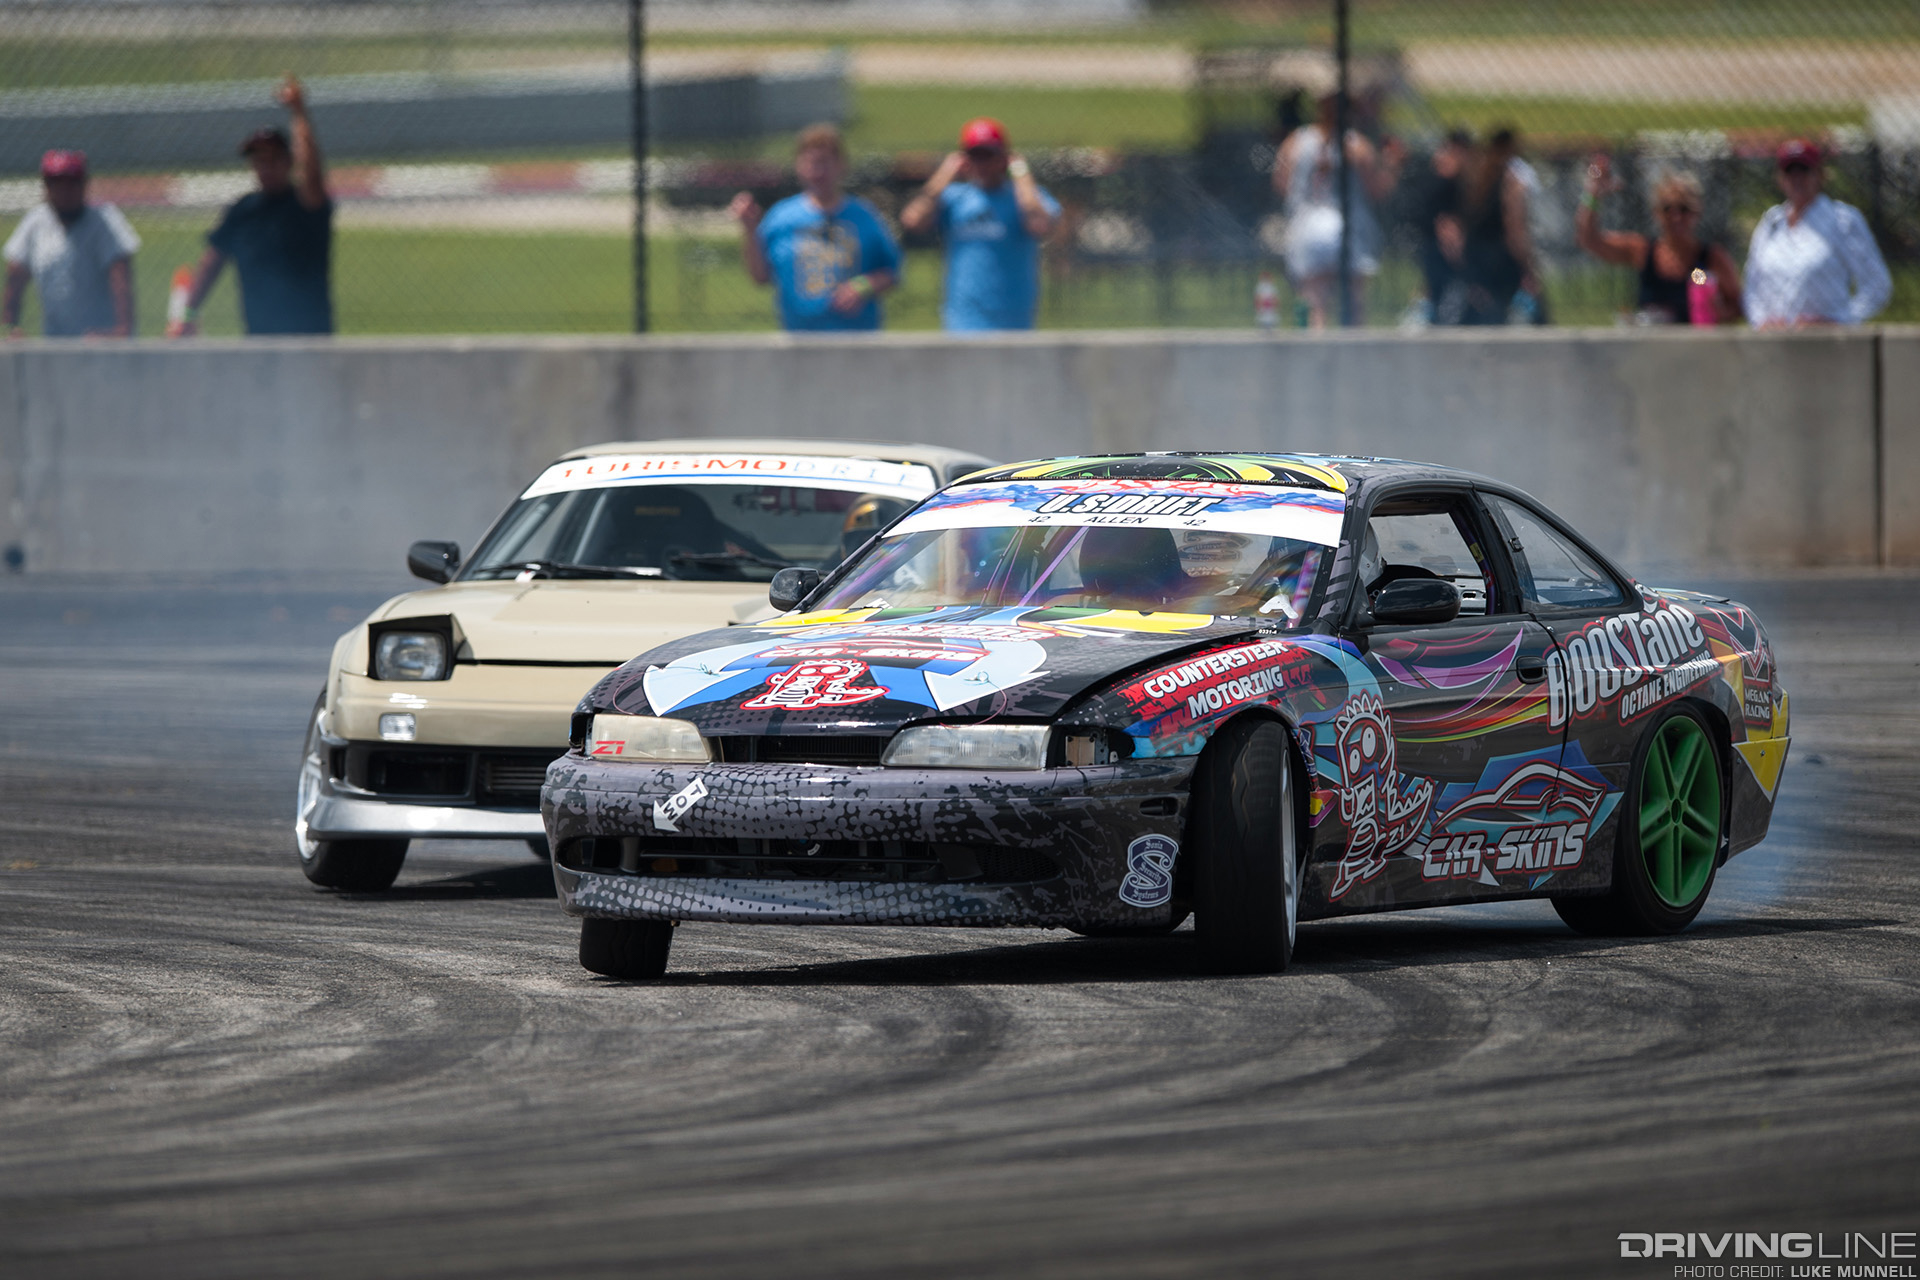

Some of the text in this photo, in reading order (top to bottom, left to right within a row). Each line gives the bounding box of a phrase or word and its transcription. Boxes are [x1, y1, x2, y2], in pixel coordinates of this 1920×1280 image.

[1028, 515, 1206, 527] 42 ALLEN 42
[1143, 641, 1289, 698] COUNTERSTEER
[1187, 665, 1284, 719] MOTORING
[1621, 650, 1719, 719] OCTANE ENGINEERING
[1745, 703, 1770, 719] RACING
[663, 784, 702, 821] TOW
